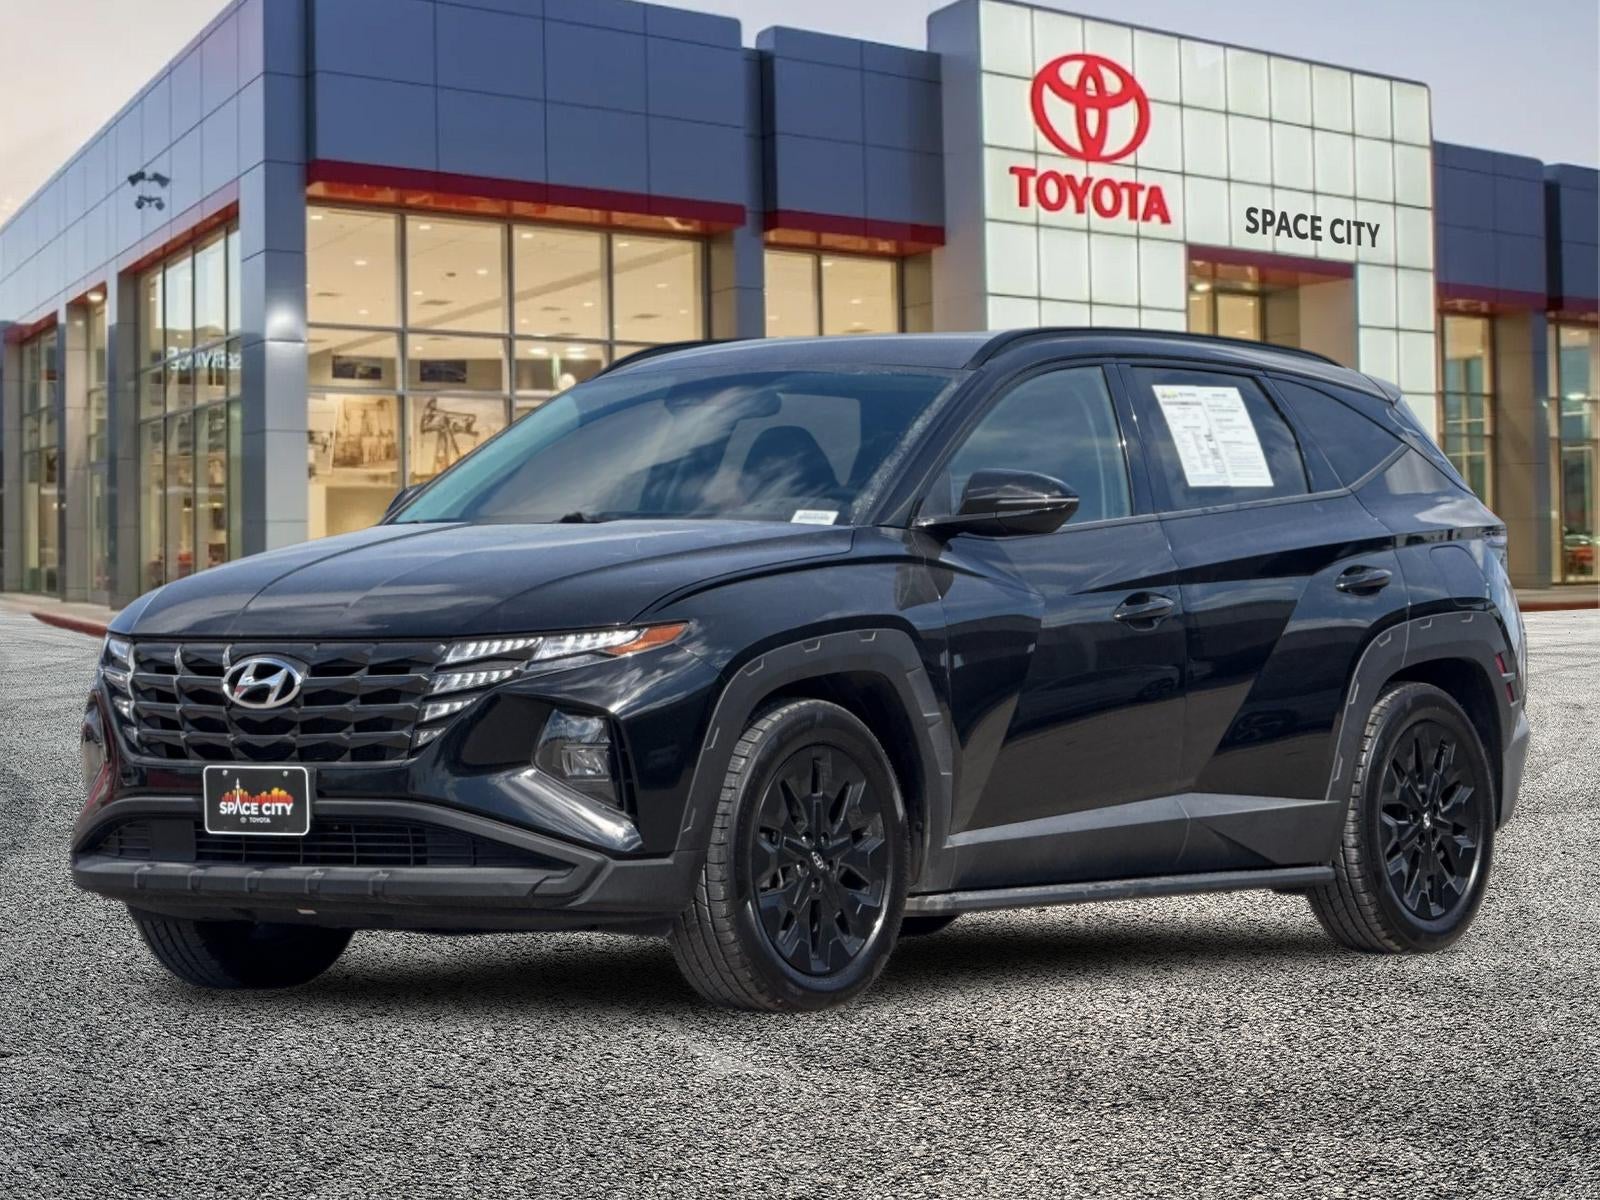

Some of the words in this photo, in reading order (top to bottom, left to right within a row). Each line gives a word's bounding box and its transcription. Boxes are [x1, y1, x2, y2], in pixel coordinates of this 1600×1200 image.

[1009, 167, 1171, 224] TOYOTA
[1245, 207, 1323, 241] SPACE
[1329, 218, 1381, 247] CITY
[219, 801, 260, 816] SPACE
[261, 803, 294, 817] CITY
